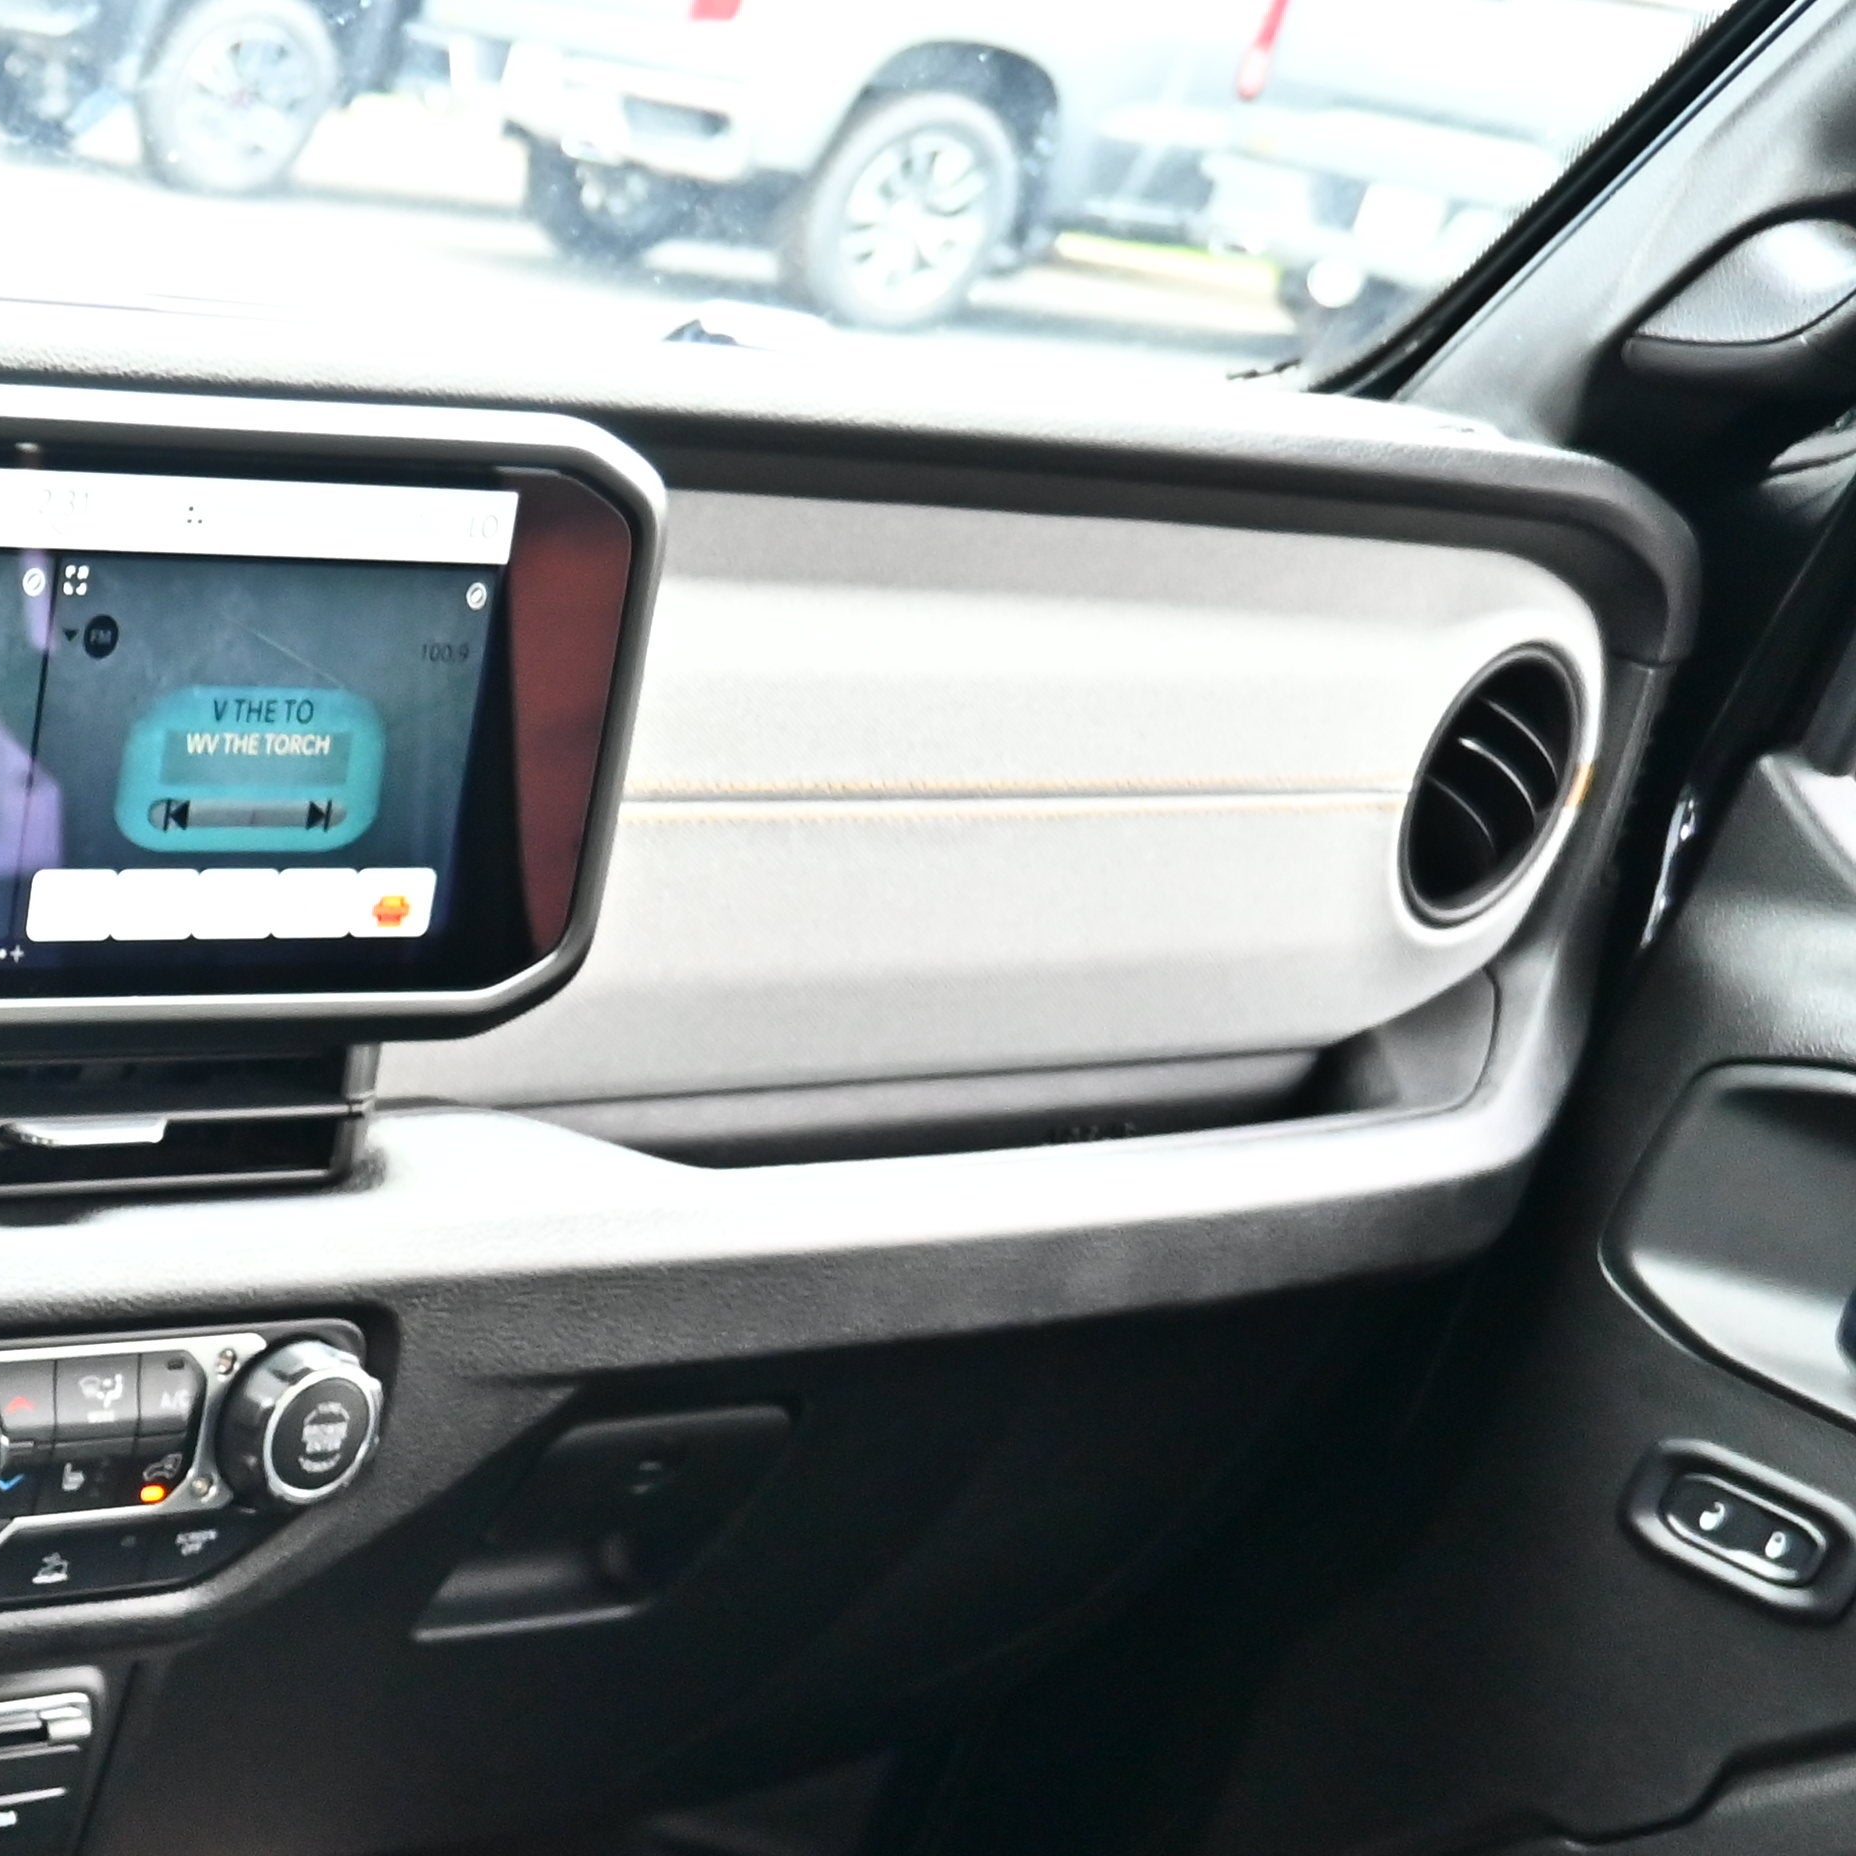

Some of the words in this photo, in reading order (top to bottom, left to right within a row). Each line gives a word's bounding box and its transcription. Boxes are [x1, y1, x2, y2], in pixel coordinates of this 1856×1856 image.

[420, 642, 470, 664] 100.9
[214, 699, 228, 723] V
[234, 699, 277, 723] THE
[285, 699, 315, 724] TO
[187, 733, 220, 755] WV
[224, 733, 259, 756] THE
[263, 733, 331, 757] TORCH
